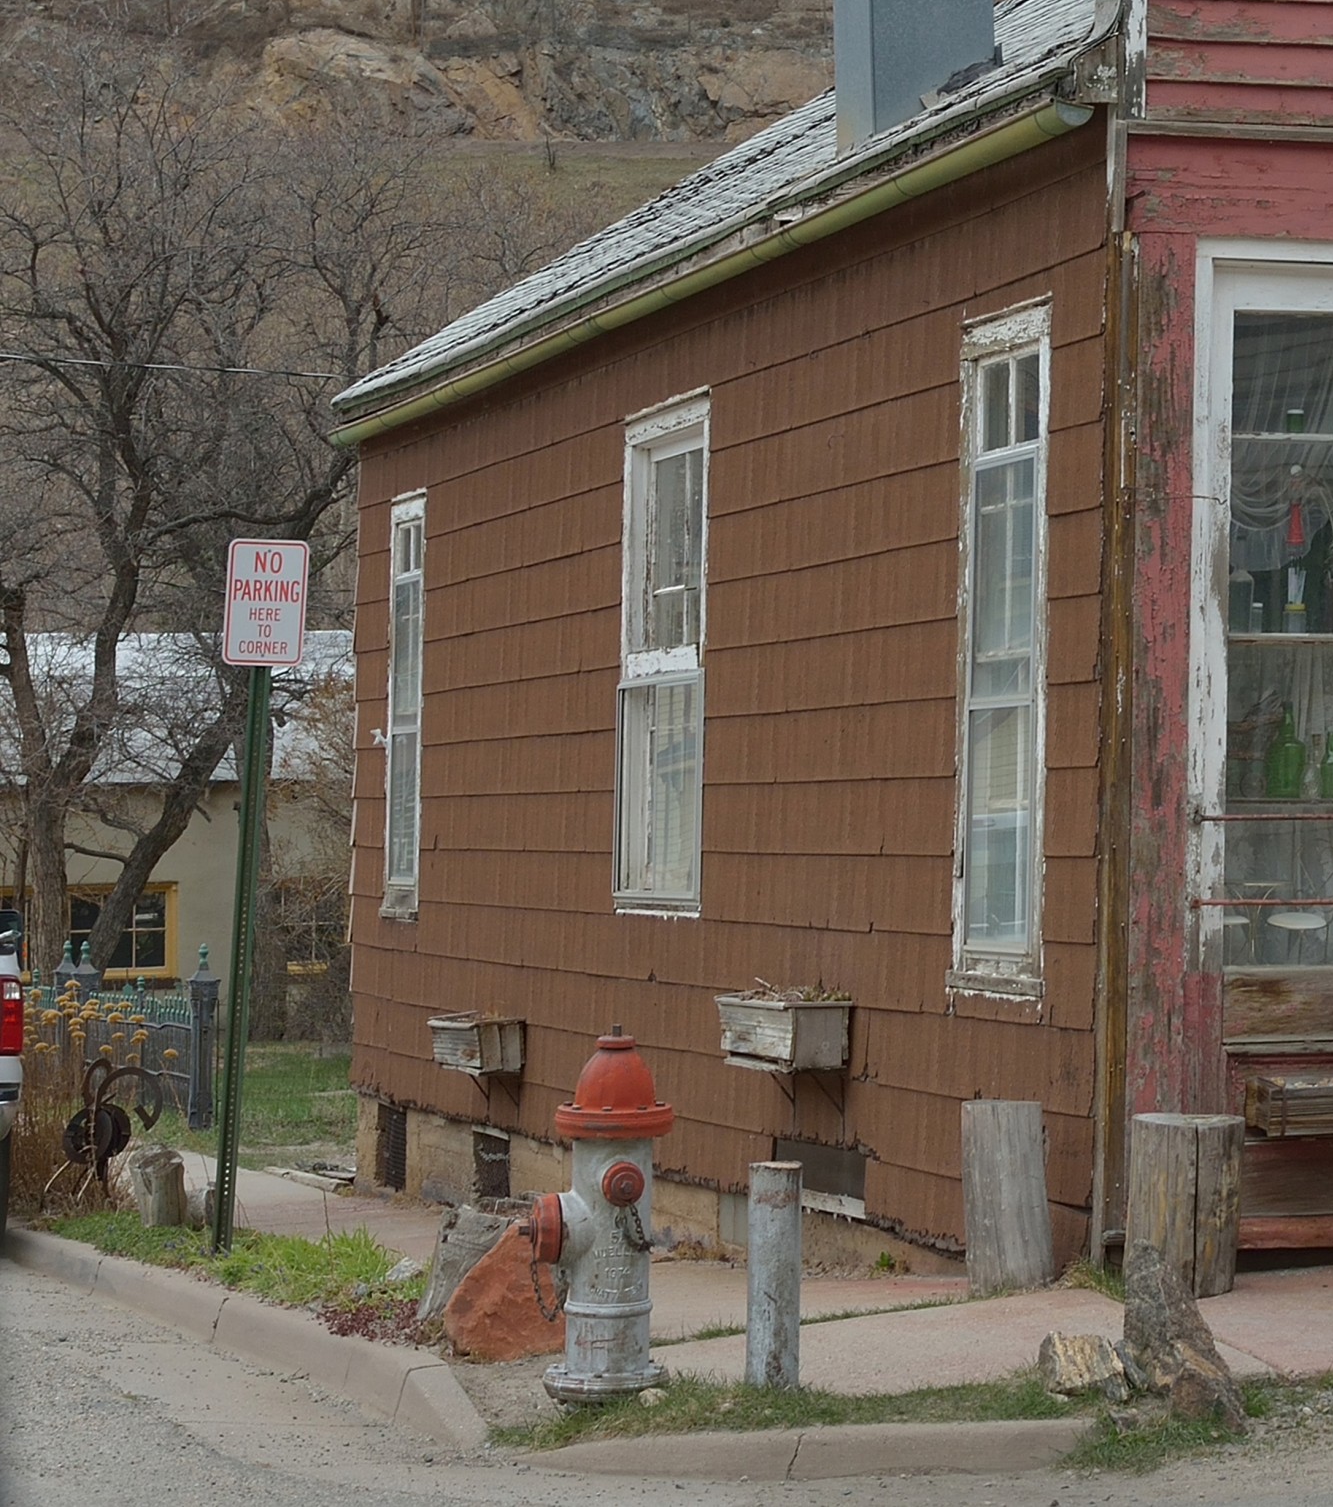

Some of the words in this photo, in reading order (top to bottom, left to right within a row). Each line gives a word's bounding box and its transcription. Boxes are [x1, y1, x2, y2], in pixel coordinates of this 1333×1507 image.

[254, 551, 283, 574] NO
[233, 579, 300, 603] PARKING
[249, 607, 281, 621] HERE
[258, 624, 272, 638] TO
[238, 640, 288, 655] CORNER
